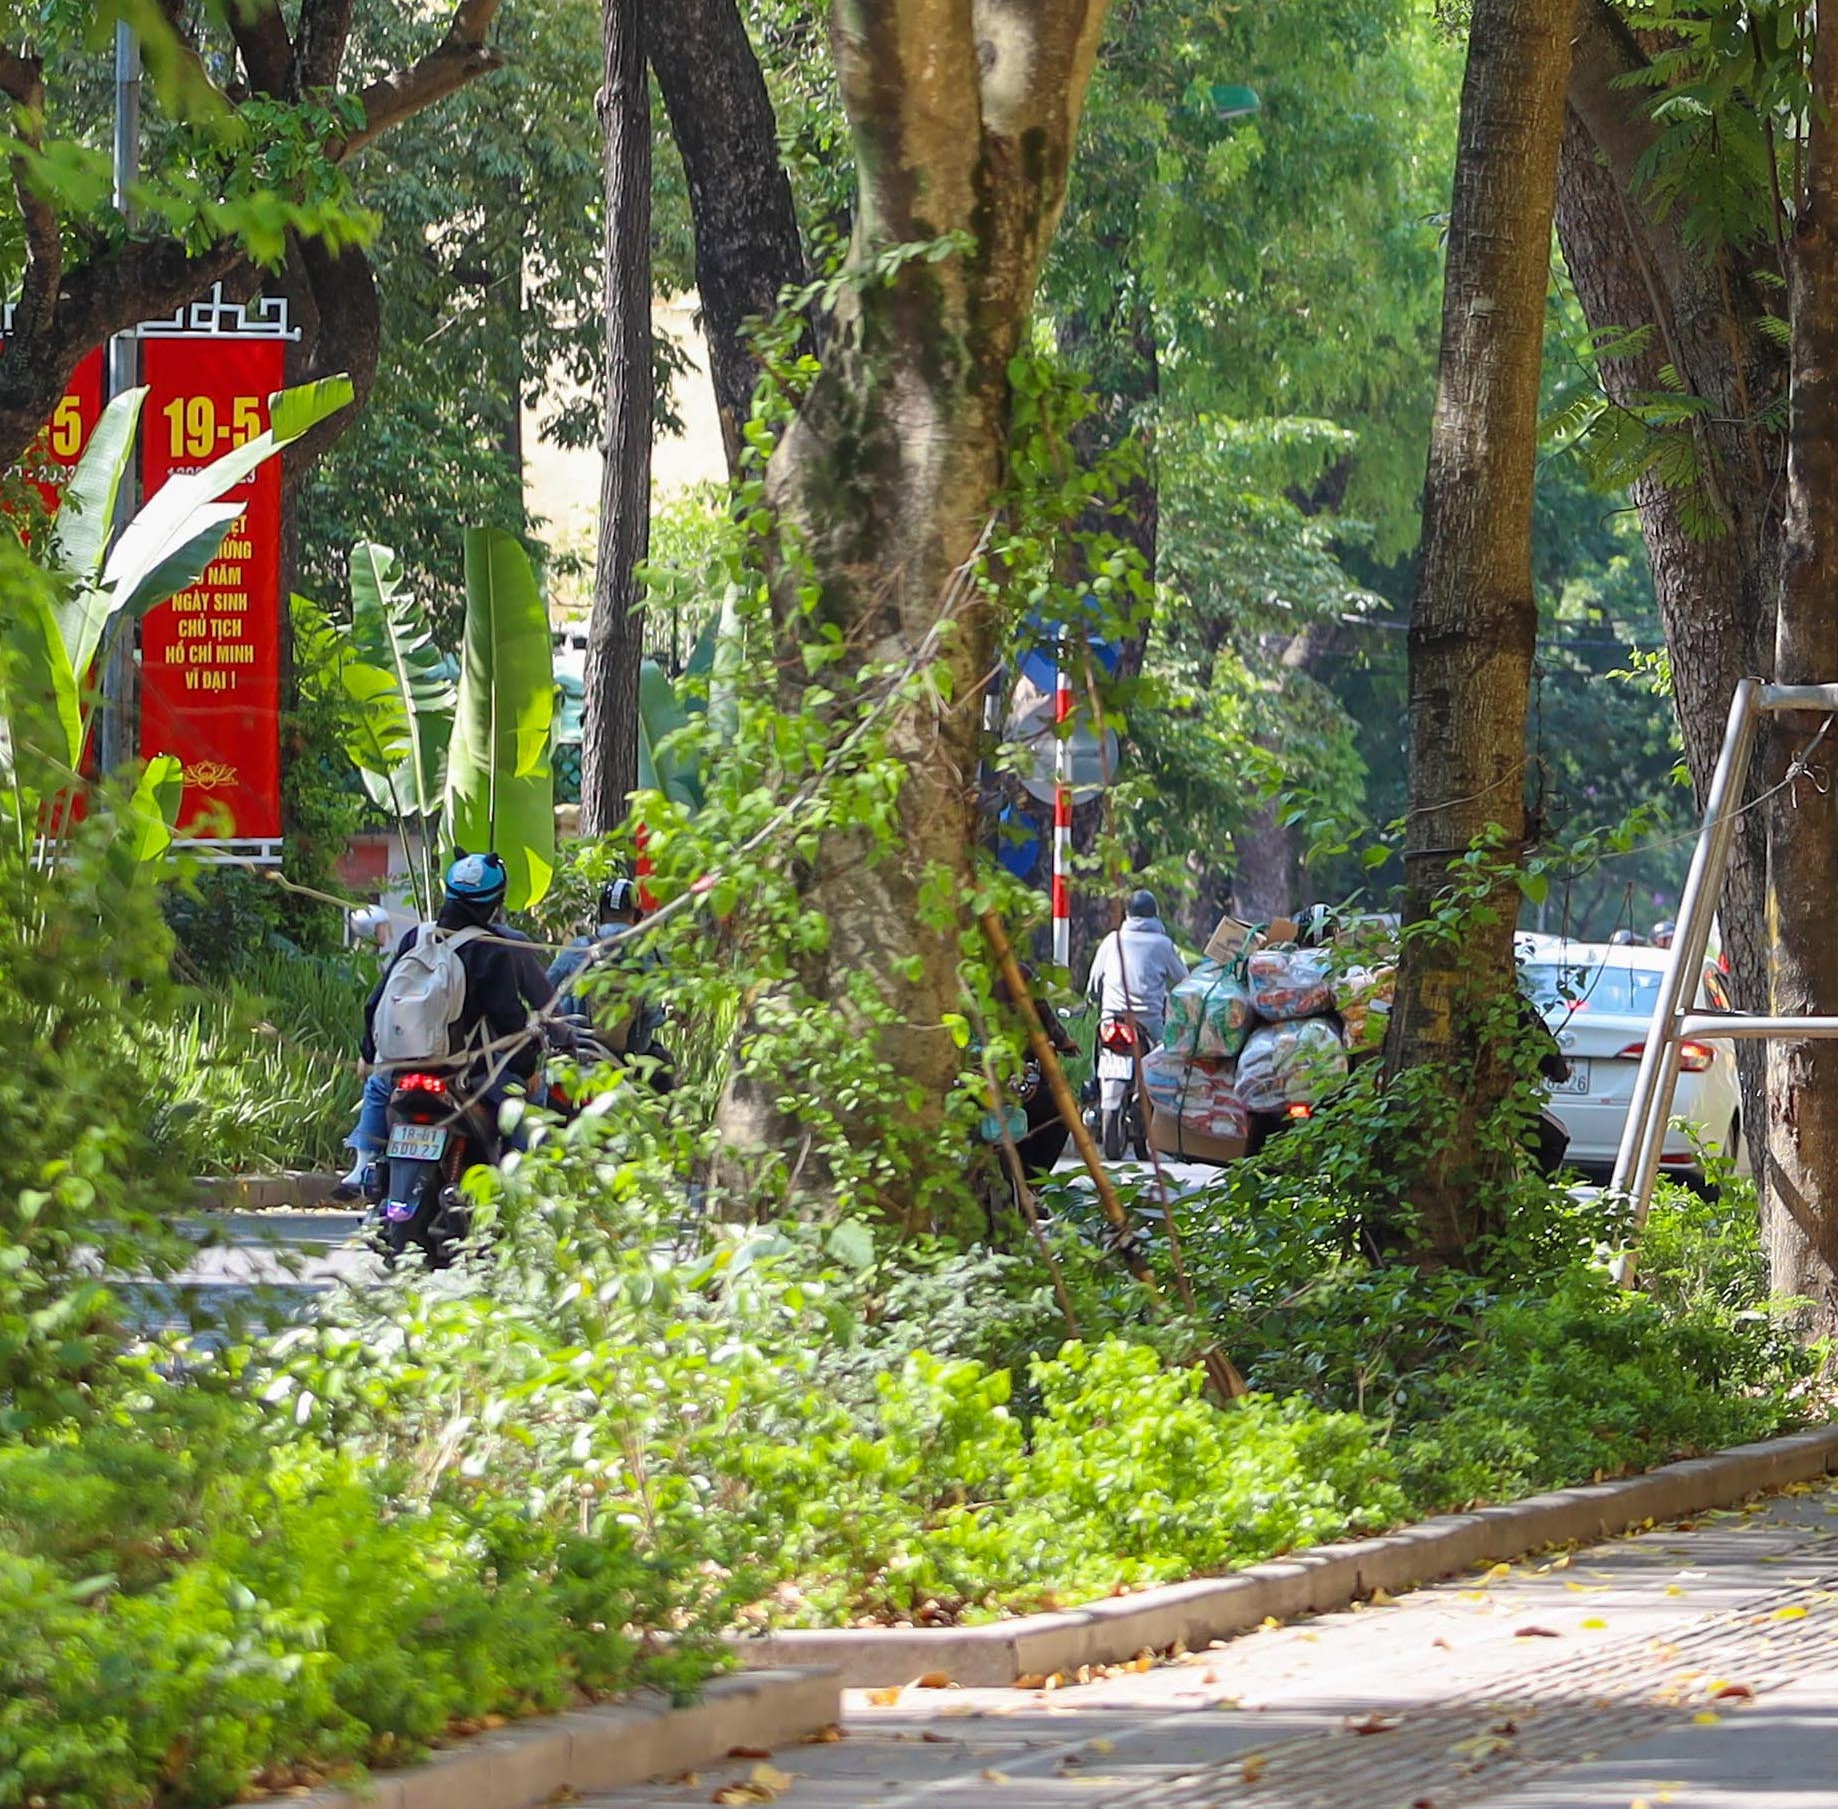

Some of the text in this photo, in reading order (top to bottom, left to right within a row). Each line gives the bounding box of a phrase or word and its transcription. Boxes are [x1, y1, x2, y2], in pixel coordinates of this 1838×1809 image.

[163, 395, 261, 458] 19-5
[207, 563, 242, 586] NĂM
[172, 589, 248, 612] NGÀY SINH
[178, 612, 242, 642] CHỦ TỊCH
[189, 641, 212, 663] CHÍ
[216, 644, 254, 664] MINH
